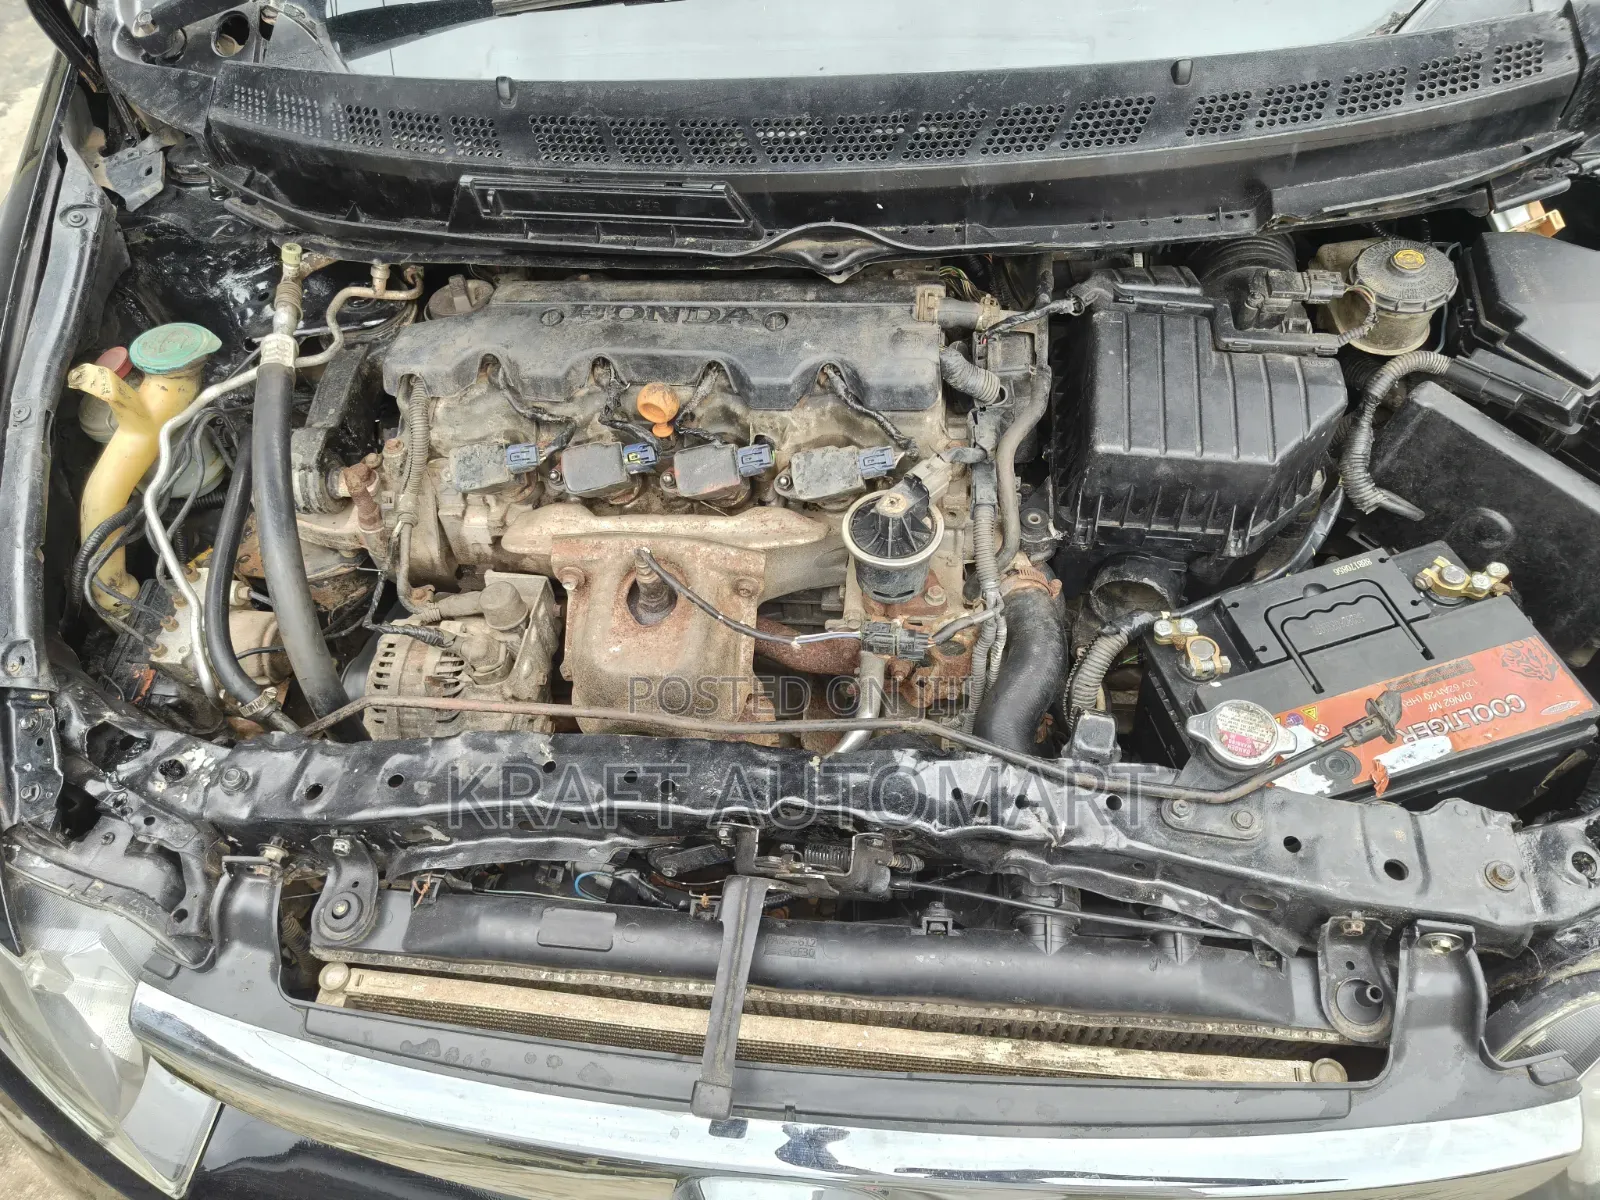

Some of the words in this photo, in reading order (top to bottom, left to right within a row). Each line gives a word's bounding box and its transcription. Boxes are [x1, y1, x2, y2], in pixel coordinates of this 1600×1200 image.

[571, 304, 757, 324] HONDA
[1443, 691, 1472, 708] DIN62
[1396, 693, 1527, 744] COOLTIGER
